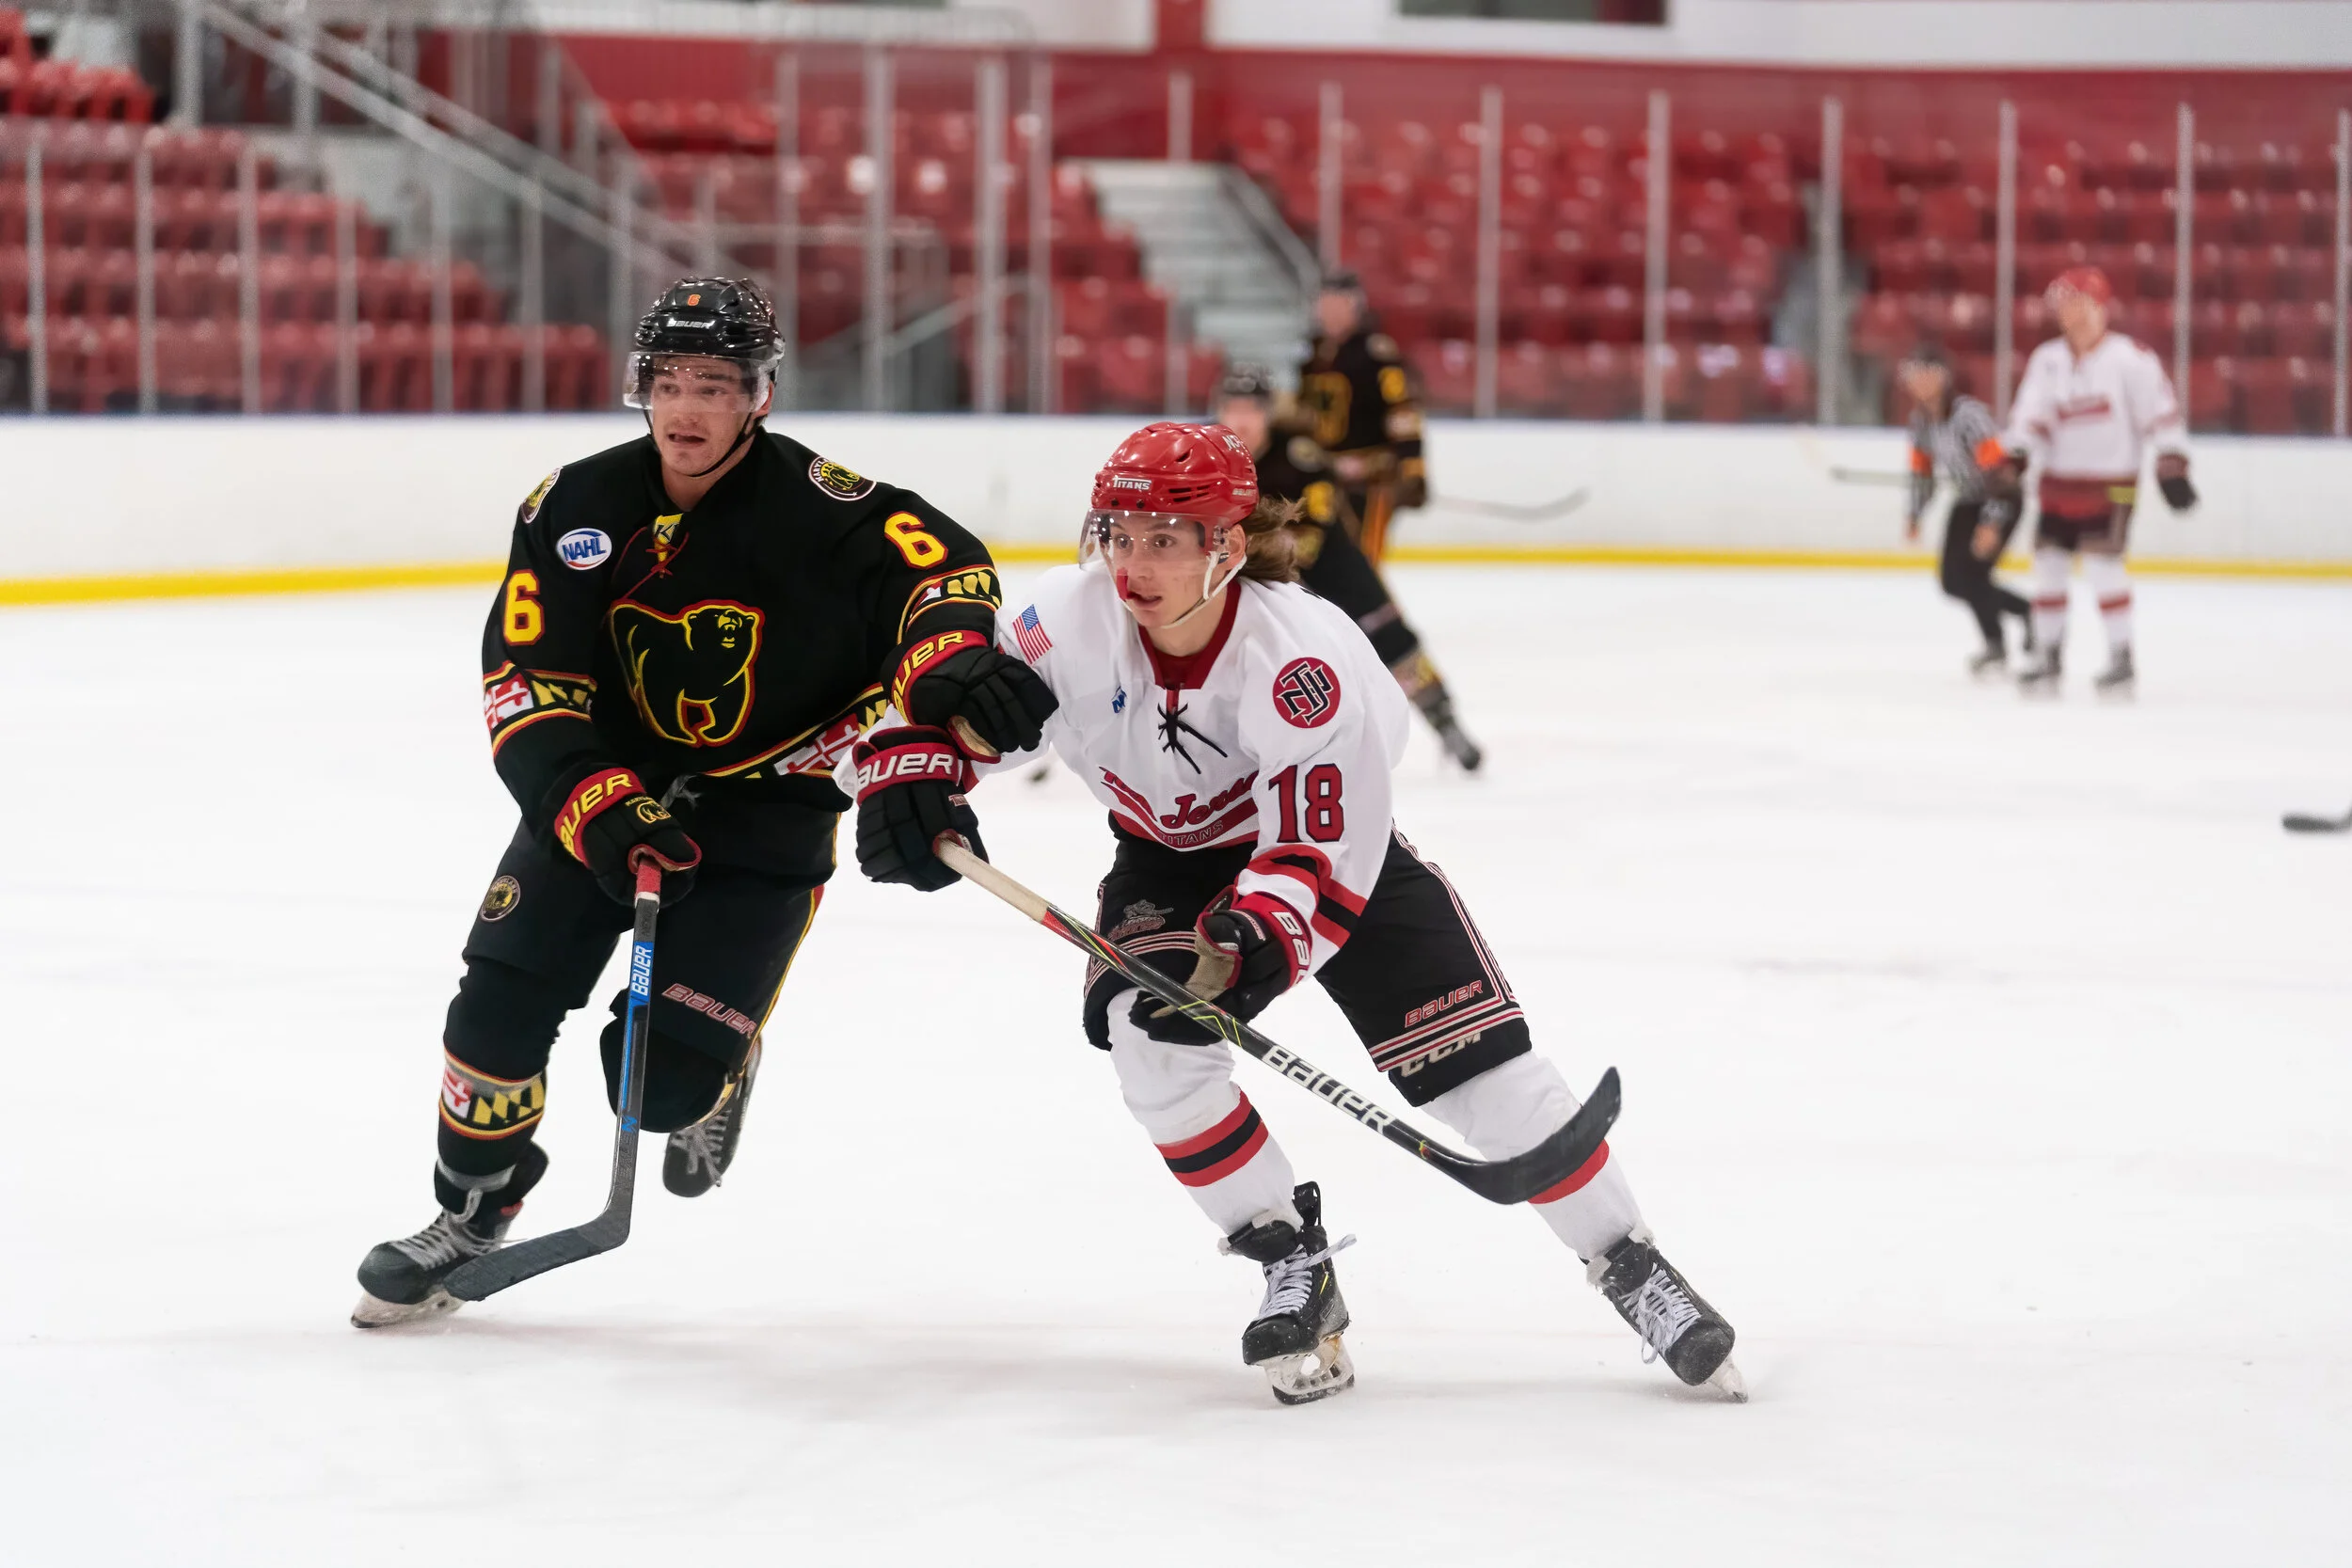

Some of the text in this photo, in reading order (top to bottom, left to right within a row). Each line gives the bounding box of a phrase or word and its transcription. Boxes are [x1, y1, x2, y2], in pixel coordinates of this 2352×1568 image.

[687, 293, 701, 306] 6
[1112, 474, 1152, 489] TITANS
[562, 537, 607, 561] NAHL
[884, 511, 948, 569] 6
[503, 569, 545, 646] 6
[893, 631, 965, 725] AUER
[857, 752, 953, 793] AUER
[560, 773, 632, 856] AUER
[1268, 763, 1344, 843] 18
[1156, 820, 1223, 846] TITANS
[631, 944, 653, 997] BAUER
[661, 982, 757, 1039] BAUER
[1405, 979, 1483, 1028] BAUER
[1262, 1044, 1396, 1135] BAUER
